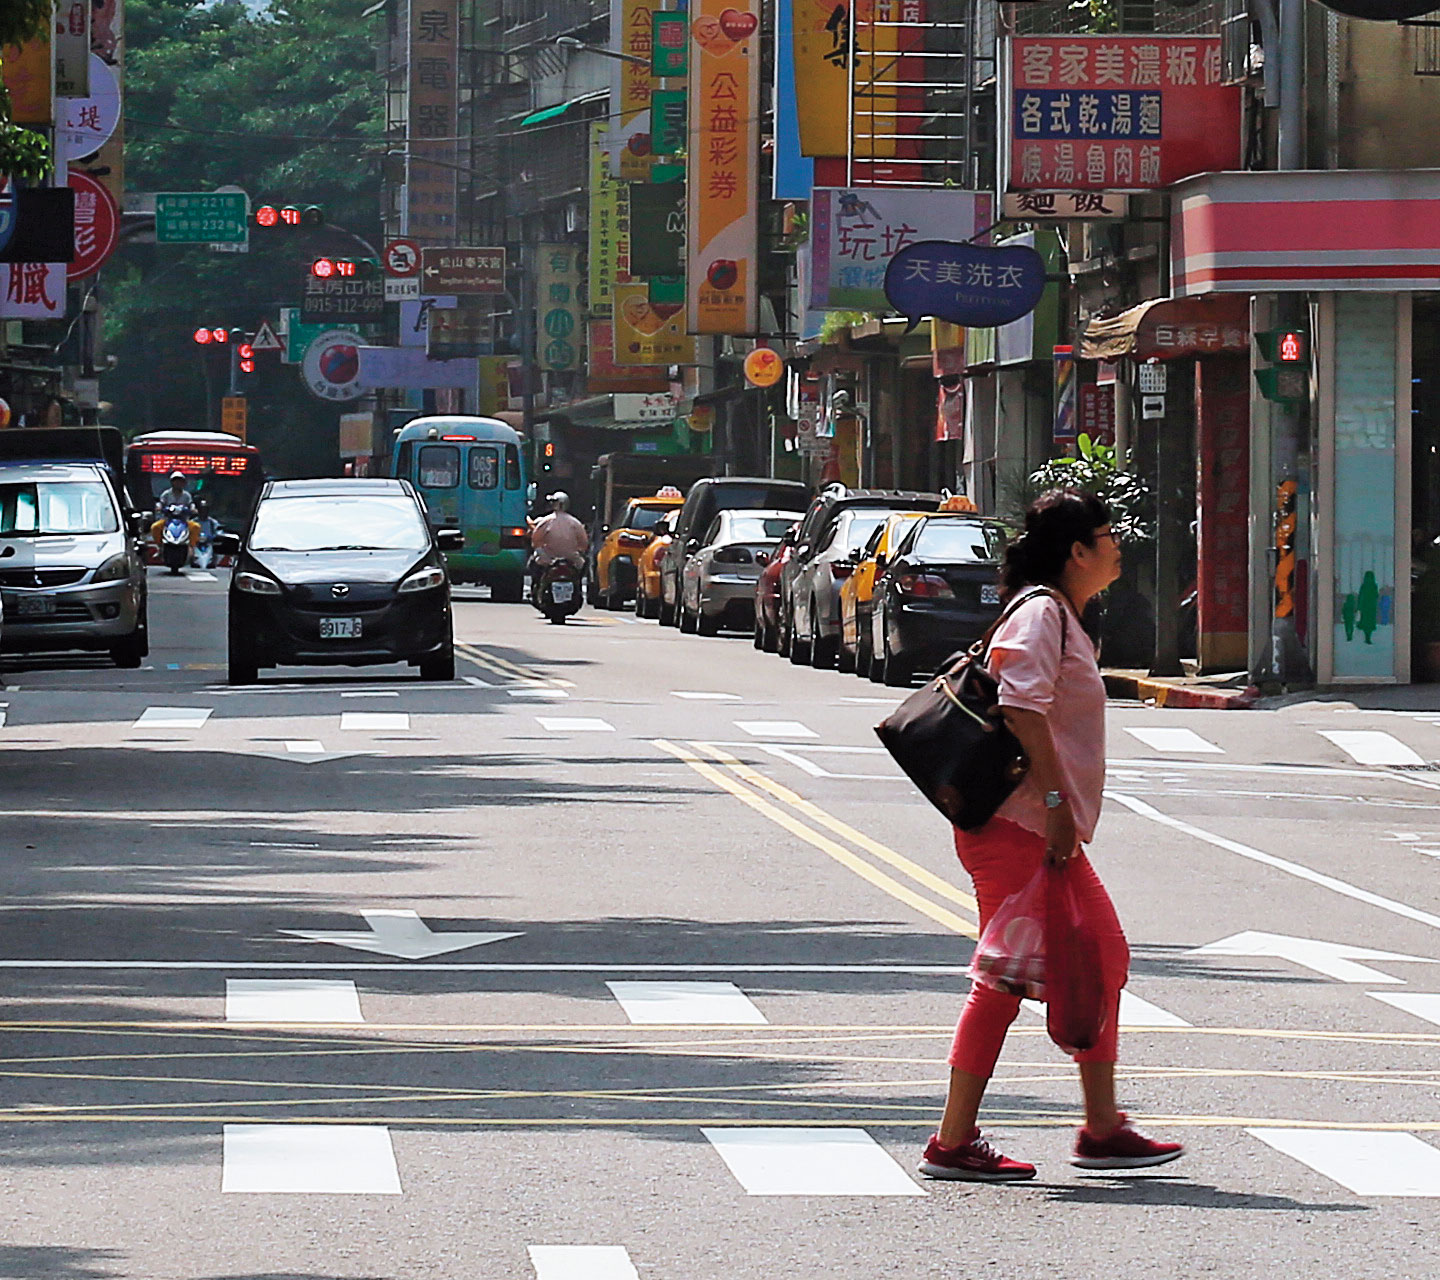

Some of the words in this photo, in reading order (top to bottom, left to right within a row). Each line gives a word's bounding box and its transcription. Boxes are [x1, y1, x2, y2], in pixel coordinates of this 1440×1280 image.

[708, 71, 739, 200] 公益彩券
[904, 258, 1024, 289] 天美洗衣
